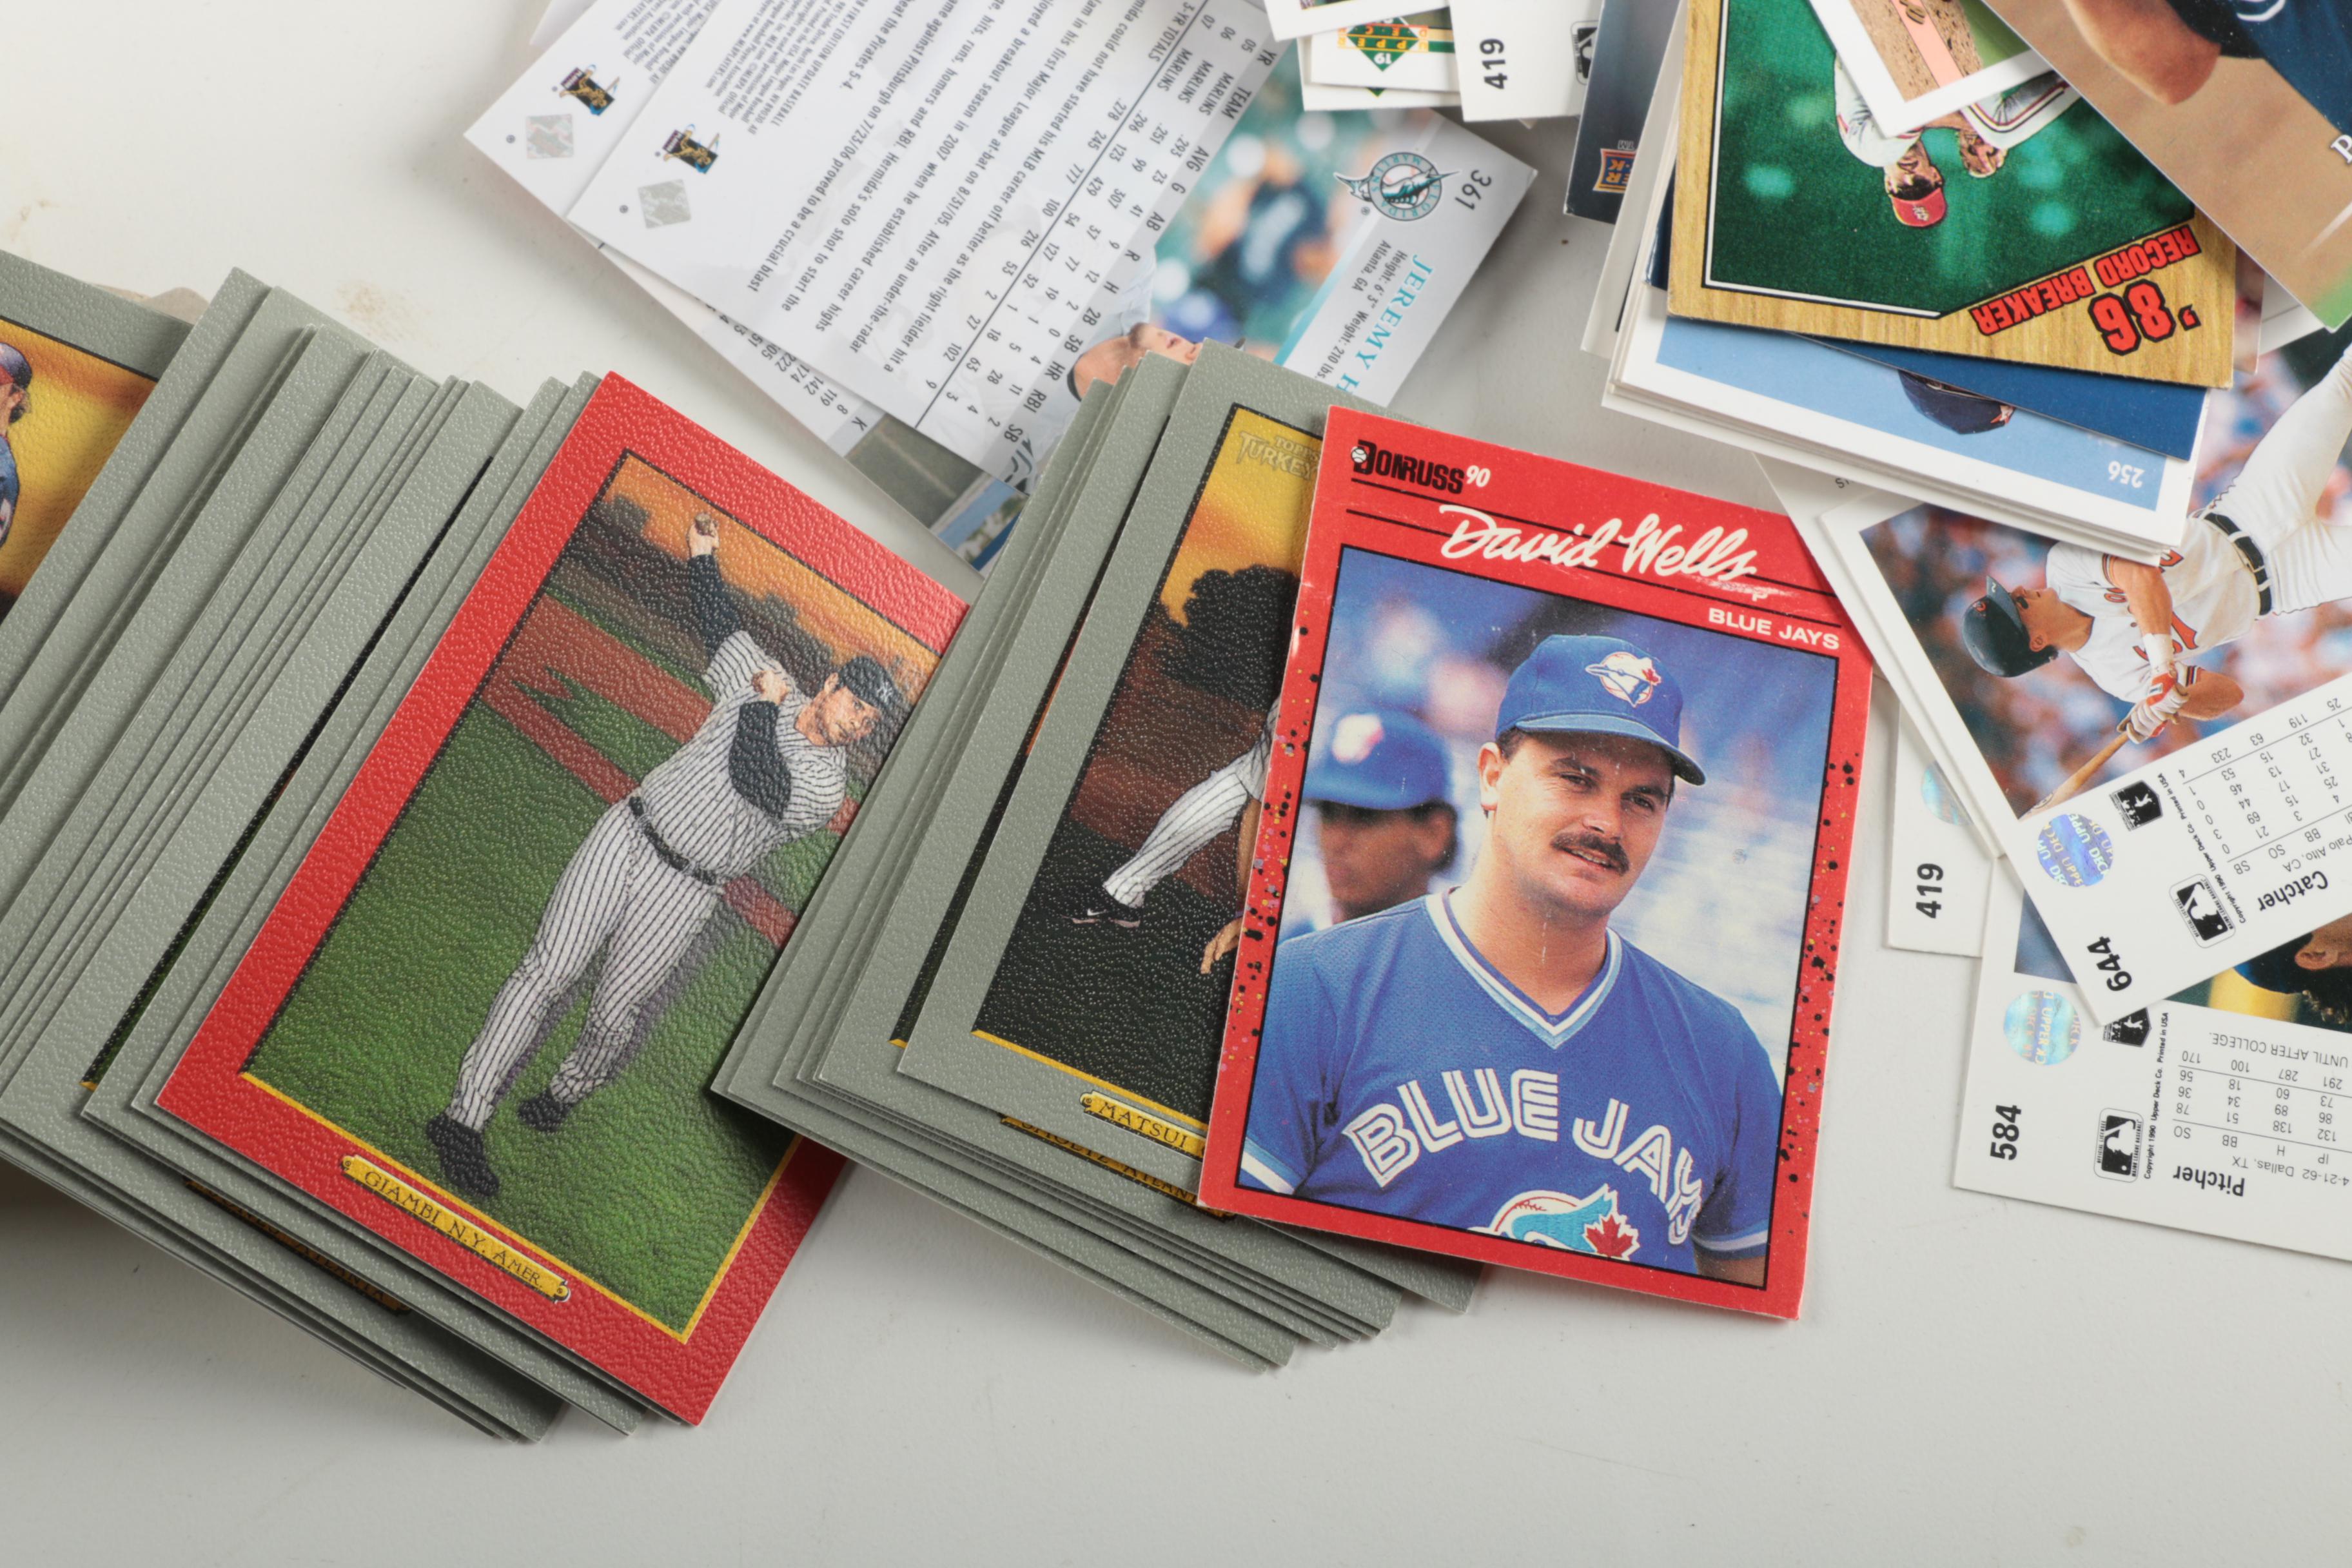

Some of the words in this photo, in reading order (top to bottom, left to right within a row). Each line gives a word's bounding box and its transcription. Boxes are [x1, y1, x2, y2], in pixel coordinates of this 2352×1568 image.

[841, 7, 860, 29] FIRST
[880, 17, 897, 34] the
[1073, 18, 1087, 28] in
[818, 28, 845, 60] EDITION
[913, 19, 942, 55] against
[1061, 30, 1079, 46] his
[1338, 36, 1428, 52] UPPER
[855, 35, 887, 69] Pirates
[1044, 48, 1066, 70] first
[1257, 50, 1277, 66] YR
[1480, 39, 1507, 89] 419
[798, 60, 822, 90] UPDATE
[842, 70, 861, 89] 5-4.
[878, 55, 920, 105] Pittsburgh
[1024, 71, 1050, 100] Major
[770, 89, 801, 126] BASEBALL
[1222, 87, 1252, 119] TEAM
[868, 106, 881, 119] on
[998, 102, 1029, 137] League
[840, 119, 874, 160] 7/23/06
[975, 139, 1001, 170] at-bat
[1186, 146, 1209, 172] AVG
[816, 158, 844, 196] proved
[965, 171, 979, 184] on
[1171, 182, 1186, 194] G
[1455, 170, 1492, 210] 361
[807, 195, 821, 206] to
[937, 186, 970, 226] 8/31/05.
[797, 206, 814, 220] be
[1146, 211, 1165, 231] AB
[766, 230, 795, 266] crucial
[917, 230, 939, 256] After
[905, 258, 918, 271] an
[1125, 250, 1141, 262] R
[1361, 240, 1391, 273] Atlanta,
[2095, 225, 2201, 288] RECORD
[1379, 250, 1407, 283] Height:
[747, 264, 773, 291] blast
[1352, 277, 1368, 291] GA
[1103, 281, 1119, 294] H
[1968, 266, 2096, 337] BREAKER
[850, 274, 908, 353] under-the-radar
[1083, 307, 1101, 326] 2B
[1355, 255, 1433, 370] JEREMY
[2088, 279, 2201, 356] '86
[1338, 311, 1369, 343] Weight:
[1064, 335, 1083, 353] 3B
[1328, 346, 1345, 364] 210
[1044, 361, 1065, 380] HR
[1023, 389, 1046, 413] RBI
[1004, 424, 1023, 443] SB
[1236, 430, 1318, 481] TURKEY
[1351, 438, 1465, 495] DONRUSS
[1465, 464, 1491, 488] 90
[2107, 460, 2145, 489] 256
[1440, 504, 1613, 569] David
[1617, 513, 1758, 582] Wells
[1708, 607, 1772, 637] BLUE
[1778, 623, 1840, 651] JAYS
[2327, 698, 2341, 711] 25
[2289, 714, 2308, 729] 119
[2249, 733, 2264, 746] 63
[2298, 732, 2313, 746] 32
[2211, 747, 2231, 763] 233
[2260, 751, 2273, 763] 15
[2309, 747, 2321, 760] 27
[2221, 768, 2236, 781] 53
[2268, 766, 2282, 778] 13
[2316, 761, 2330, 774] 31
[2158, 773, 2169, 788] USA
[2278, 780, 2290, 792] 17
[2324, 776, 2338, 789] 25
[2230, 784, 2242, 796] 46
[2170, 796, 2187, 819] Printed
[2239, 798, 2250, 809] 44
[2285, 794, 2298, 807] 15
[2247, 811, 2260, 825] 69
[2255, 825, 2269, 839] 21
[2304, 828, 2321, 842] BB
[2193, 834, 2205, 851] Deck
[2268, 844, 2286, 859] SO
[2302, 847, 2326, 860] Alto,
[2203, 853, 2216, 872] Upper
[2233, 860, 2250, 875] SB
[2282, 859, 2301, 872] CA
[2215, 874, 2226, 890] 1990
[1914, 862, 1945, 920] 419
[2258, 871, 2328, 911] Catcher
[2226, 892, 2246, 923] Copyright
[2087, 936, 2132, 991] 644
[2210, 1033, 2266, 1054] COLLEGE.
[2182, 1050, 2200, 1064] 170
[2271, 1044, 2309, 1061] AFTER
[2313, 1052, 2348, 1068] UNTIL
[2231, 1059, 2249, 1073] 100
[2180, 1070, 2193, 1082] 56
[2278, 1069, 2298, 1082] 287
[2324, 1077, 2342, 1090] 291
[2178, 1086, 2192, 1099] 36
[2228, 1079, 2240, 1091] 18
[2228, 1096, 2240, 1108] 34
[2276, 1088, 2289, 1100] 60
[2320, 1095, 2333, 1108] 73
[2144, 1144, 2155, 1179] Copyright
[2151, 1101, 2159, 1121] Upper
[2157, 1037, 2166, 1063] Printed
[2176, 1102, 2190, 1115] 78
[2275, 1104, 2288, 1117] 89
[1098, 1101, 1188, 1148] MATSUI
[2227, 1112, 2239, 1124] 51
[2318, 1112, 2333, 1124] 86
[1343, 1067, 1559, 1189] BLUE
[1990, 1105, 2021, 1161] 584
[2173, 1126, 2191, 1139] SO
[2273, 1121, 2292, 1133] 138
[2317, 1128, 2336, 1142] 132
[2222, 1135, 2237, 1148] BB
[2277, 1144, 2285, 1157] H
[2317, 1153, 2329, 1164] IP
[2232, 1156, 2248, 1169] TX
[2255, 1159, 2294, 1177] Dallas,
[2173, 1166, 2245, 1197] Pitcher
[2302, 1169, 2349, 1186] 4-21-62
[363, 1169, 442, 1225] GIAMBI
[451, 1219, 488, 1259] N.Y.
[494, 1249, 543, 1289] AMER.
